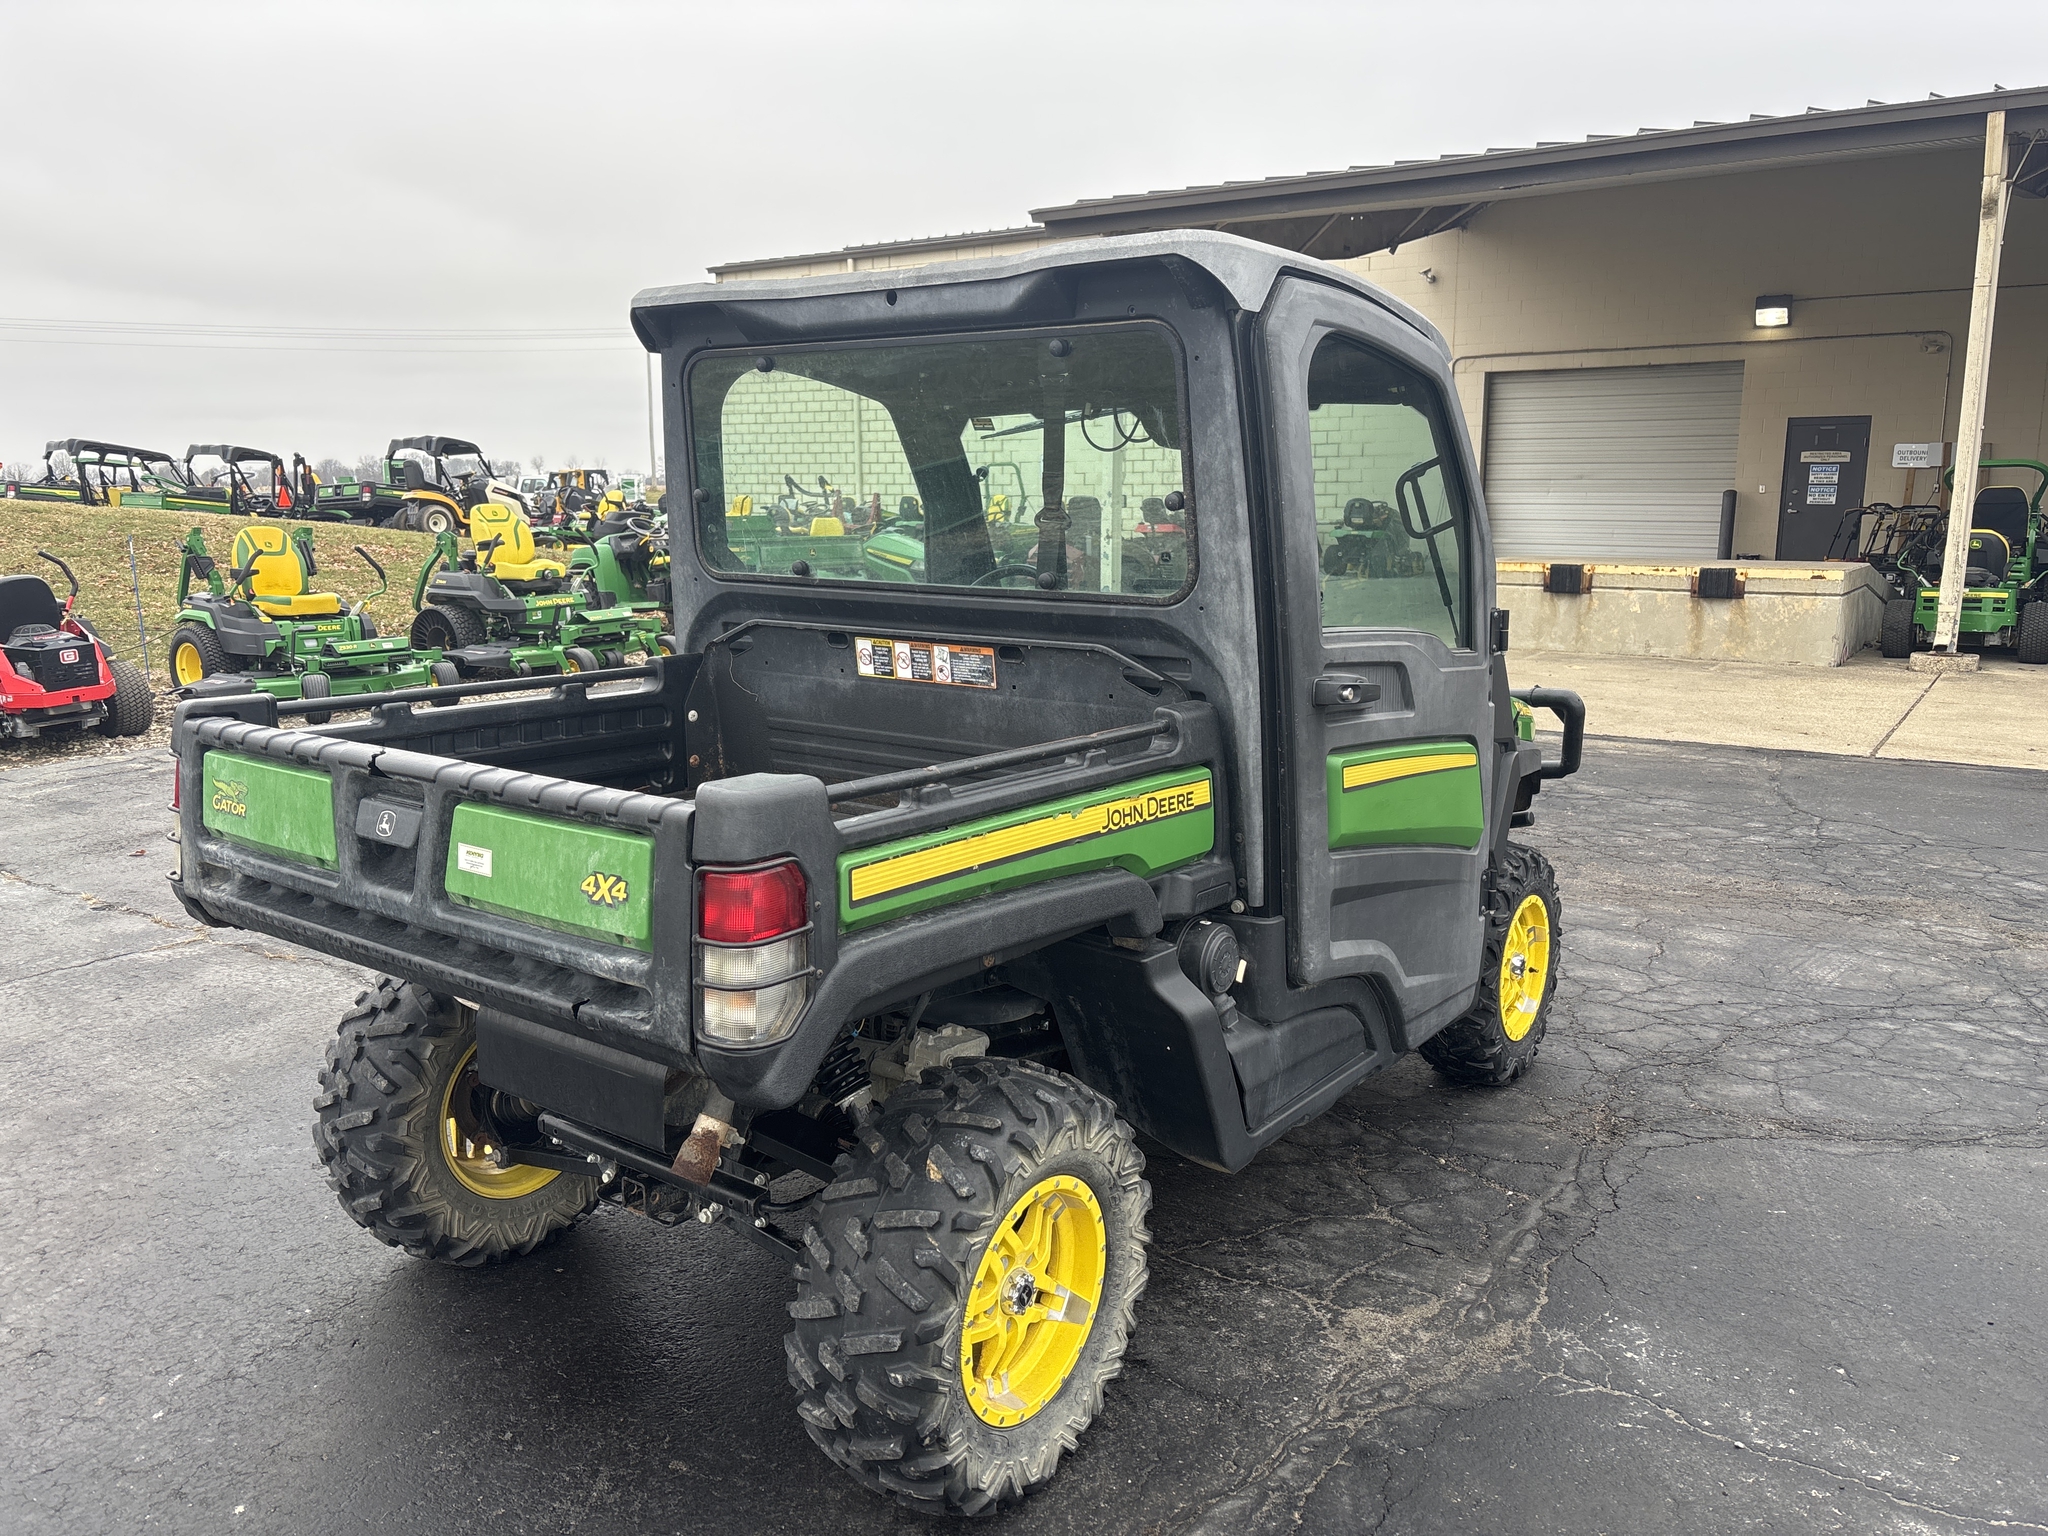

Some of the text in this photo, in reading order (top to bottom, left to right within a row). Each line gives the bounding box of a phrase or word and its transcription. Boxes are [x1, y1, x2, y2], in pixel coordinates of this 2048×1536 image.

[317, 624, 342, 632] DEERE
[212, 794, 247, 817] GATOR
[1101, 791, 1195, 830] JOHN DEERE
[580, 872, 628, 906] 4X4
